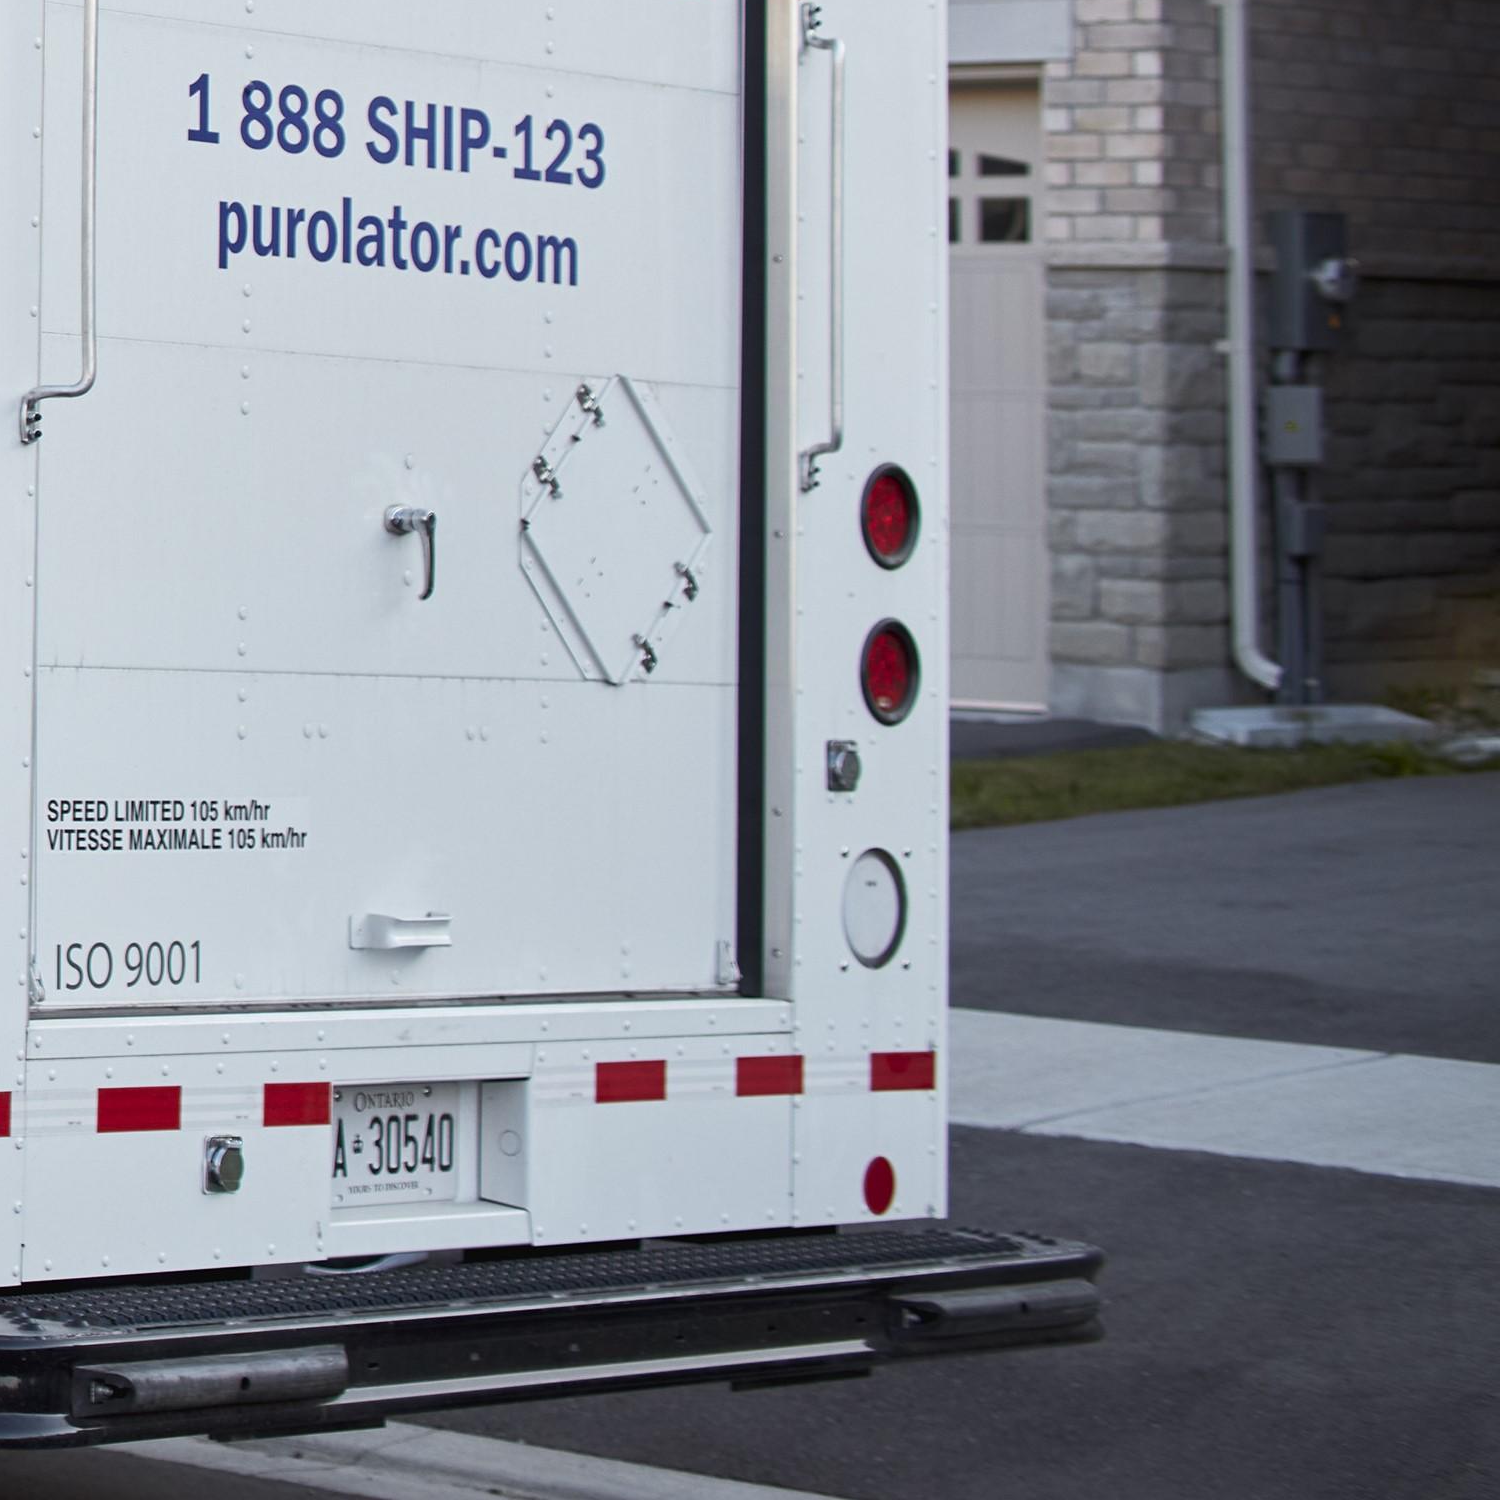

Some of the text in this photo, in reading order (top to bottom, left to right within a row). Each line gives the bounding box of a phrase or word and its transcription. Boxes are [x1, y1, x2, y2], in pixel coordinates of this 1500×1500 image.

[188, 73, 606, 189] 1 888 SHIP-123
[218, 197, 578, 286] purolator.com
[47, 799, 271, 822] SPEED LIMITED 105 km/hr
[47, 827, 307, 851] VITESSE MAXIMALE 105 km/hr
[56, 940, 200, 990] ISO 9001
